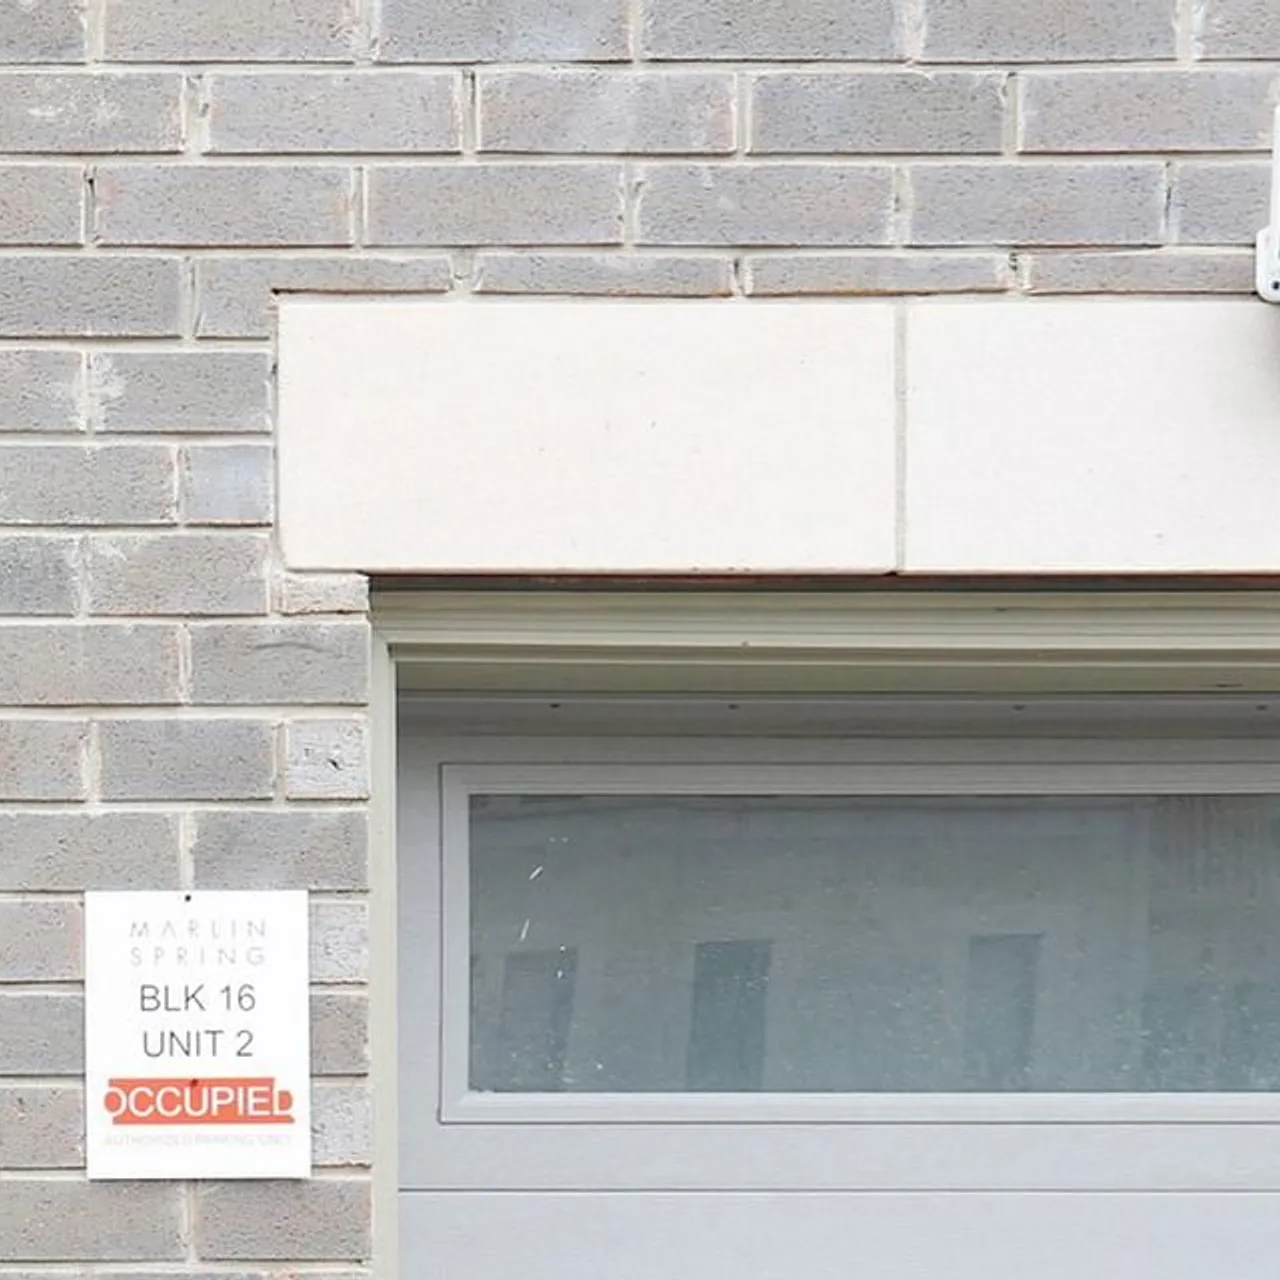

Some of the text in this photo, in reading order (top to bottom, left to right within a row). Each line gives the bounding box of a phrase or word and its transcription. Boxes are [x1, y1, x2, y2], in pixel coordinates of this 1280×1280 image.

[130, 919, 266, 938] MARLIN
[130, 946, 266, 966] SPRING
[140, 983, 256, 1012] BLK 16
[143, 1029, 254, 1057] UNIT 2
[103, 1085, 295, 1118] OCCUPIED
